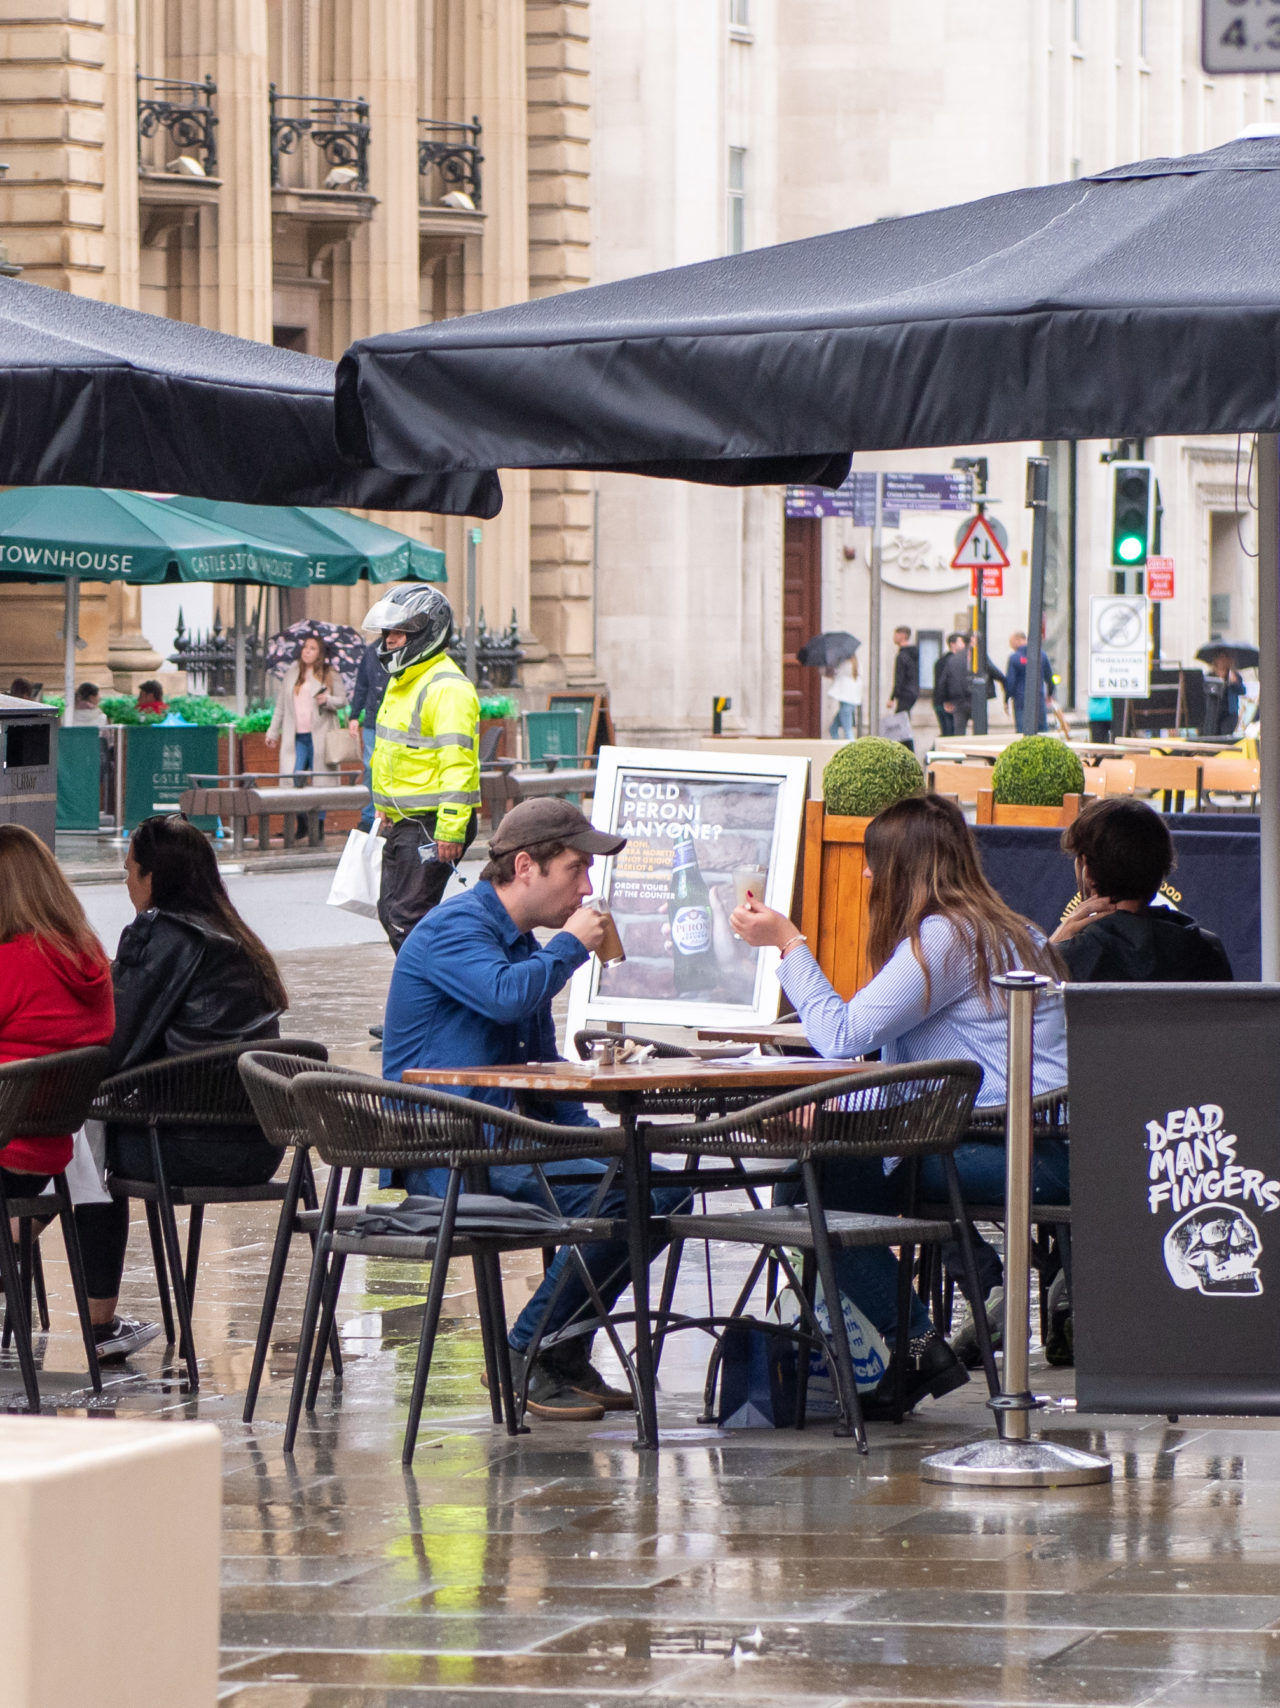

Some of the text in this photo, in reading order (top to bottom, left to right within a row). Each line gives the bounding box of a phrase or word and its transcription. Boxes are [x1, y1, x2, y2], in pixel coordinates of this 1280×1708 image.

[191, 554, 227, 574] CASTLE
[1098, 678, 1140, 688] ENDS
[625, 782, 680, 800] COLD
[623, 801, 701, 821] PERONI
[620, 820, 723, 841] ANYONE?
[614, 882, 669, 892] ORDER YOURS
[624, 890, 639, 898] THE
[639, 891, 676, 900] COUNTER
[1146, 1103, 1225, 1152] DEAD
[1149, 1130, 1238, 1184] MAN'S
[1148, 1166, 1280, 1214] FINGERS
